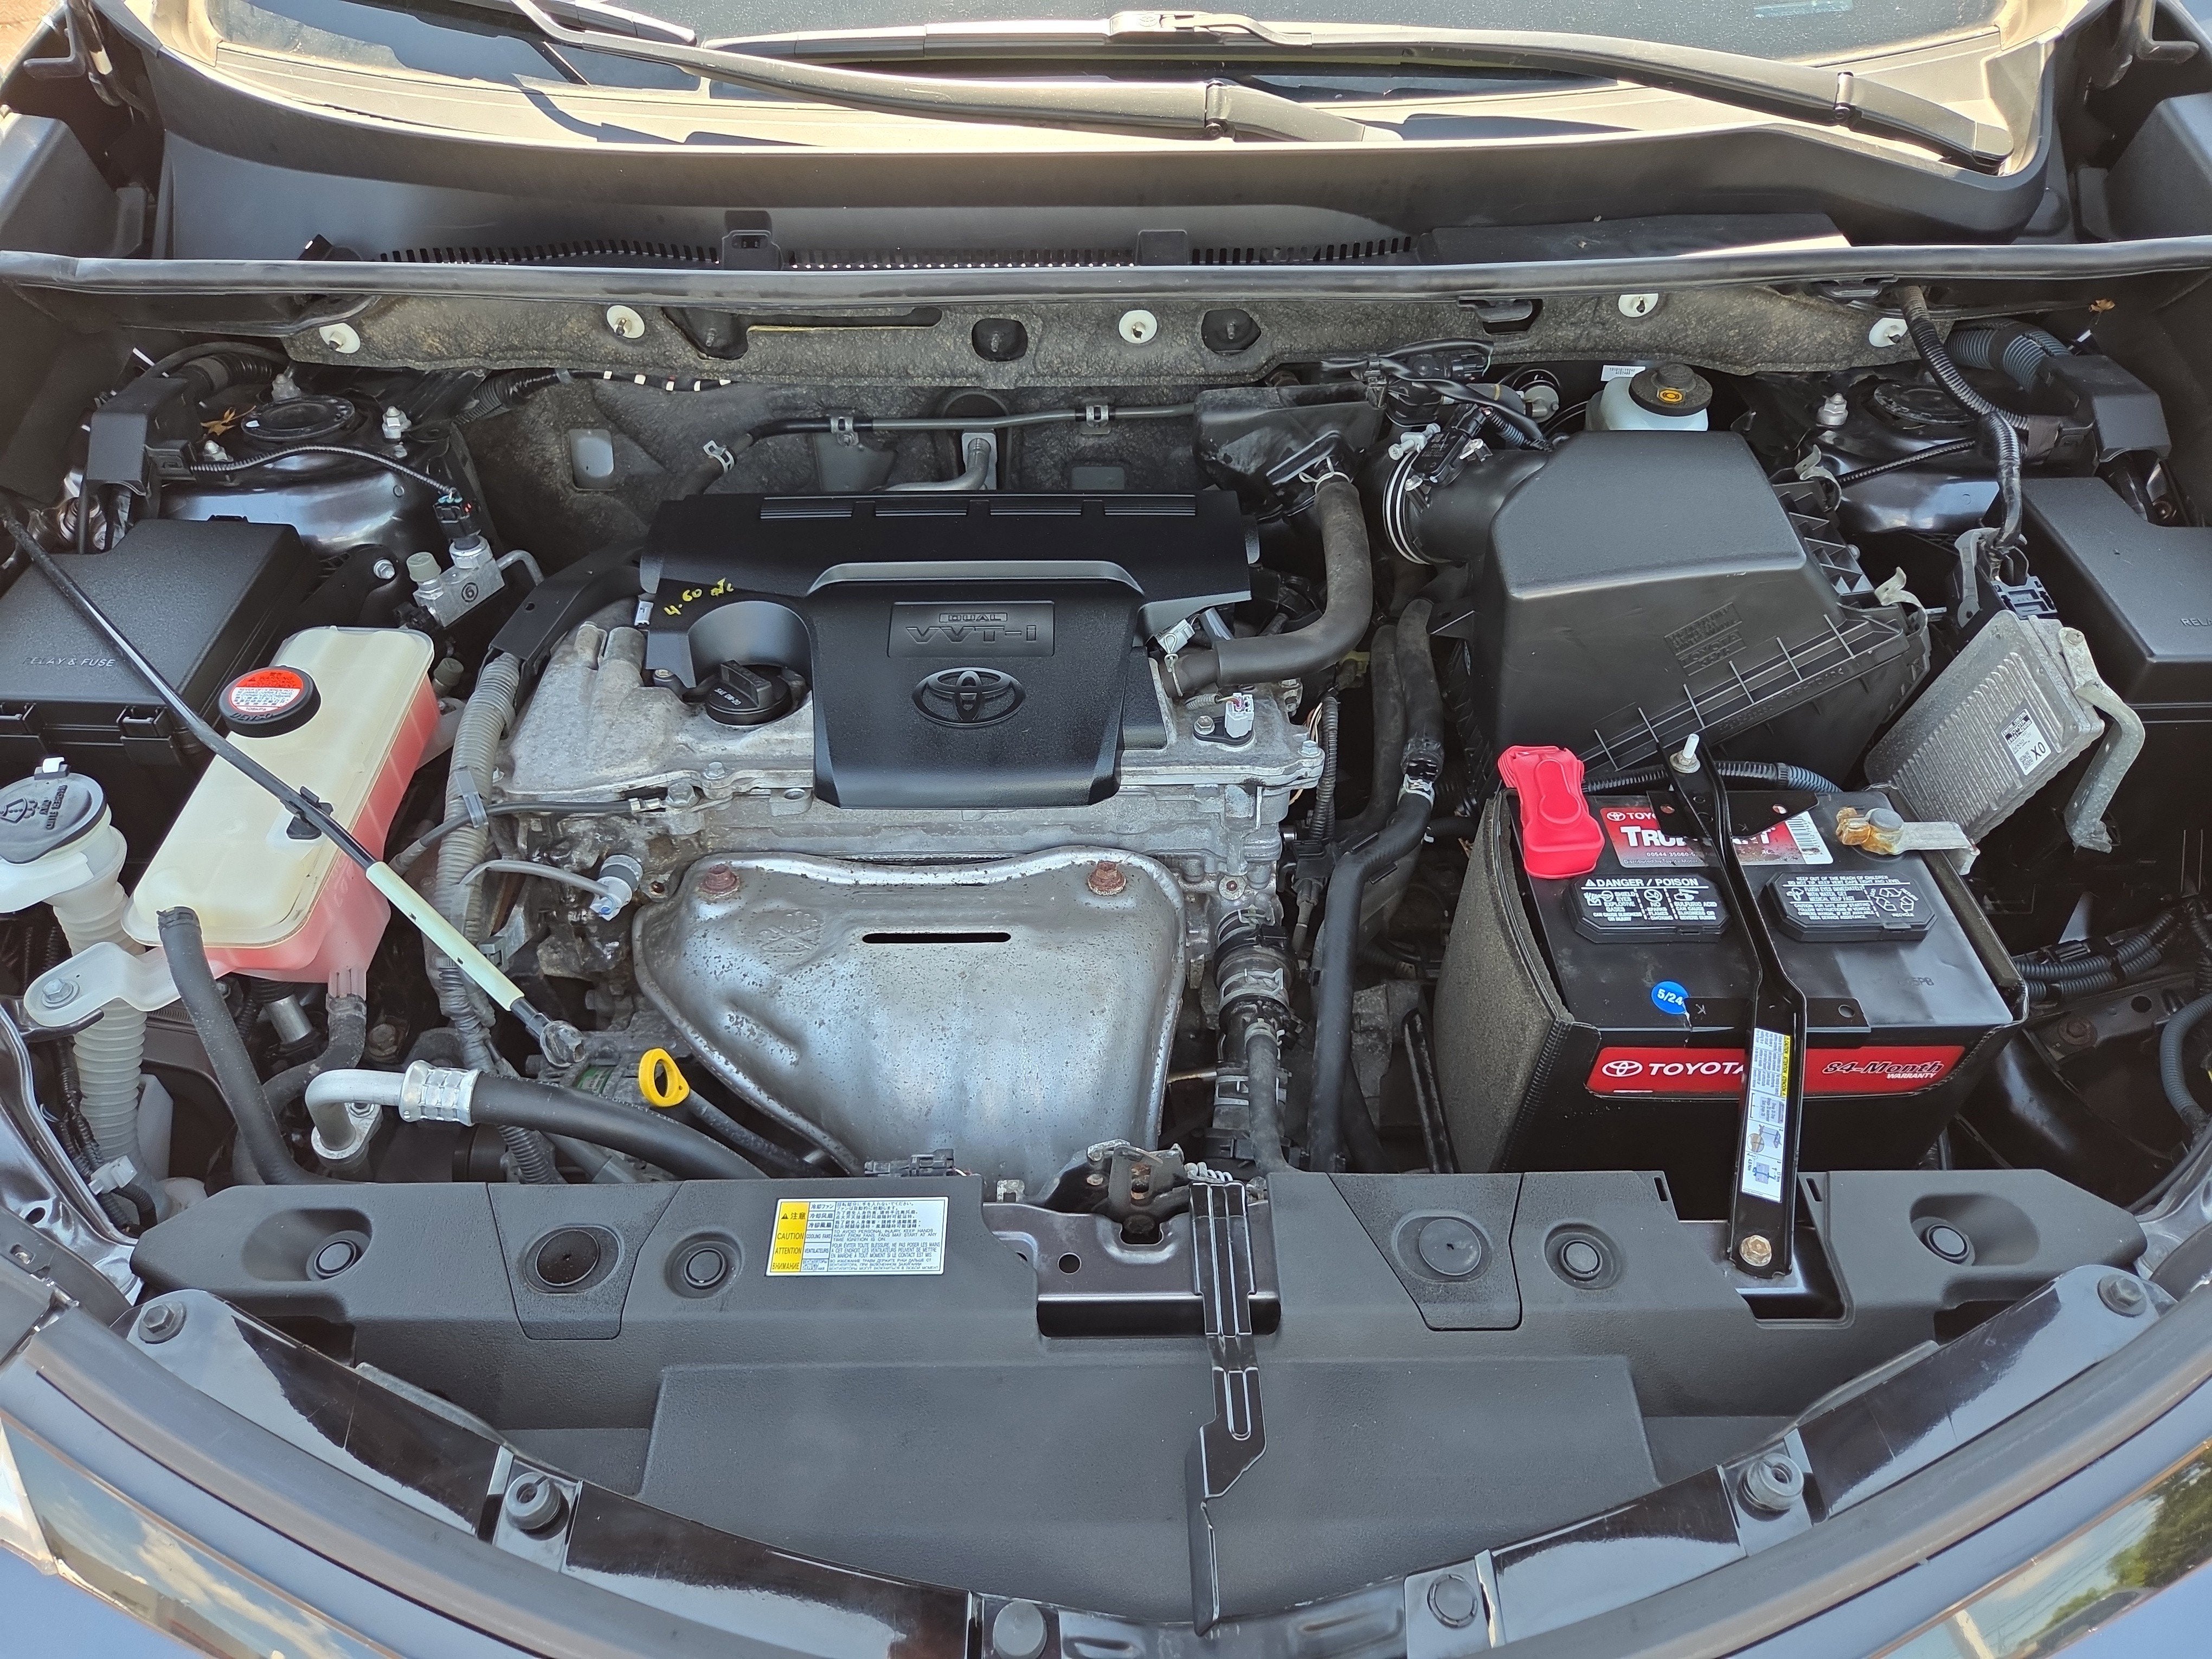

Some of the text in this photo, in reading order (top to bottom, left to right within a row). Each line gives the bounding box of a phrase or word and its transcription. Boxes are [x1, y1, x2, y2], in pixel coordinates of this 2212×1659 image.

[948, 613, 1001, 622] DUAL
[906, 625, 1037, 644] VVT-i
[68, 658, 77, 666] &
[81, 658, 115, 667] FUSE
[2010, 719, 2026, 736] TOYOTA
[1657, 988, 1683, 1006] 5/24
[1822, 1061, 1944, 1075] 84-Month
